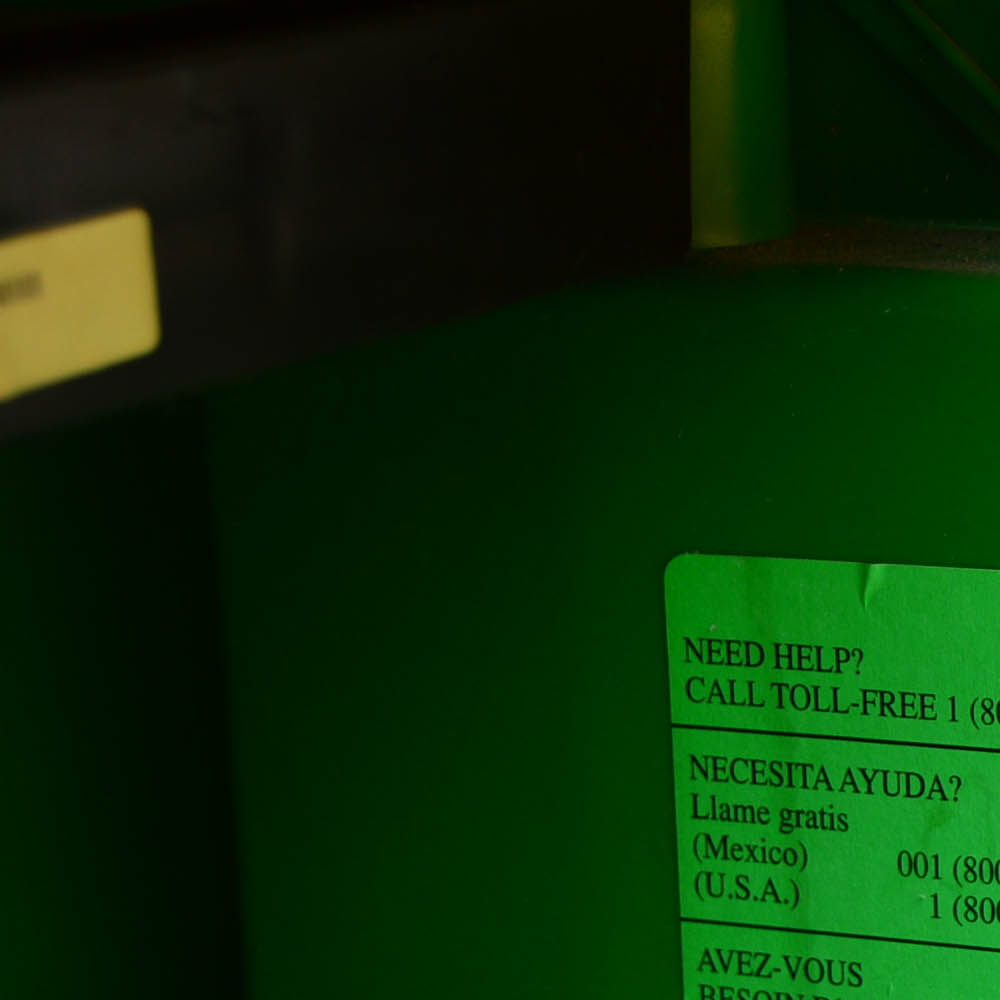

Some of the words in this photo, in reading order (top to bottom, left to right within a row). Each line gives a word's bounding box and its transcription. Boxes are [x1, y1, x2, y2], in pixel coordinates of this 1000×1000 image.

[682, 636, 766, 669] NEED
[772, 641, 865, 676] HELP?
[684, 675, 766, 709] CALL
[769, 681, 938, 721] TOLL-FREE
[947, 695, 960, 723] 1
[688, 753, 834, 792] NECESITA
[837, 765, 963, 803] AYUDA?
[690, 792, 771, 826] Llame
[778, 803, 849, 836] gratis
[692, 832, 809, 873] (Mexico)
[896, 849, 943, 881] 001
[694, 870, 801, 911] (U.S.A.)
[929, 892, 942, 920] 1
[697, 947, 864, 988] AVEZ-VOUS
